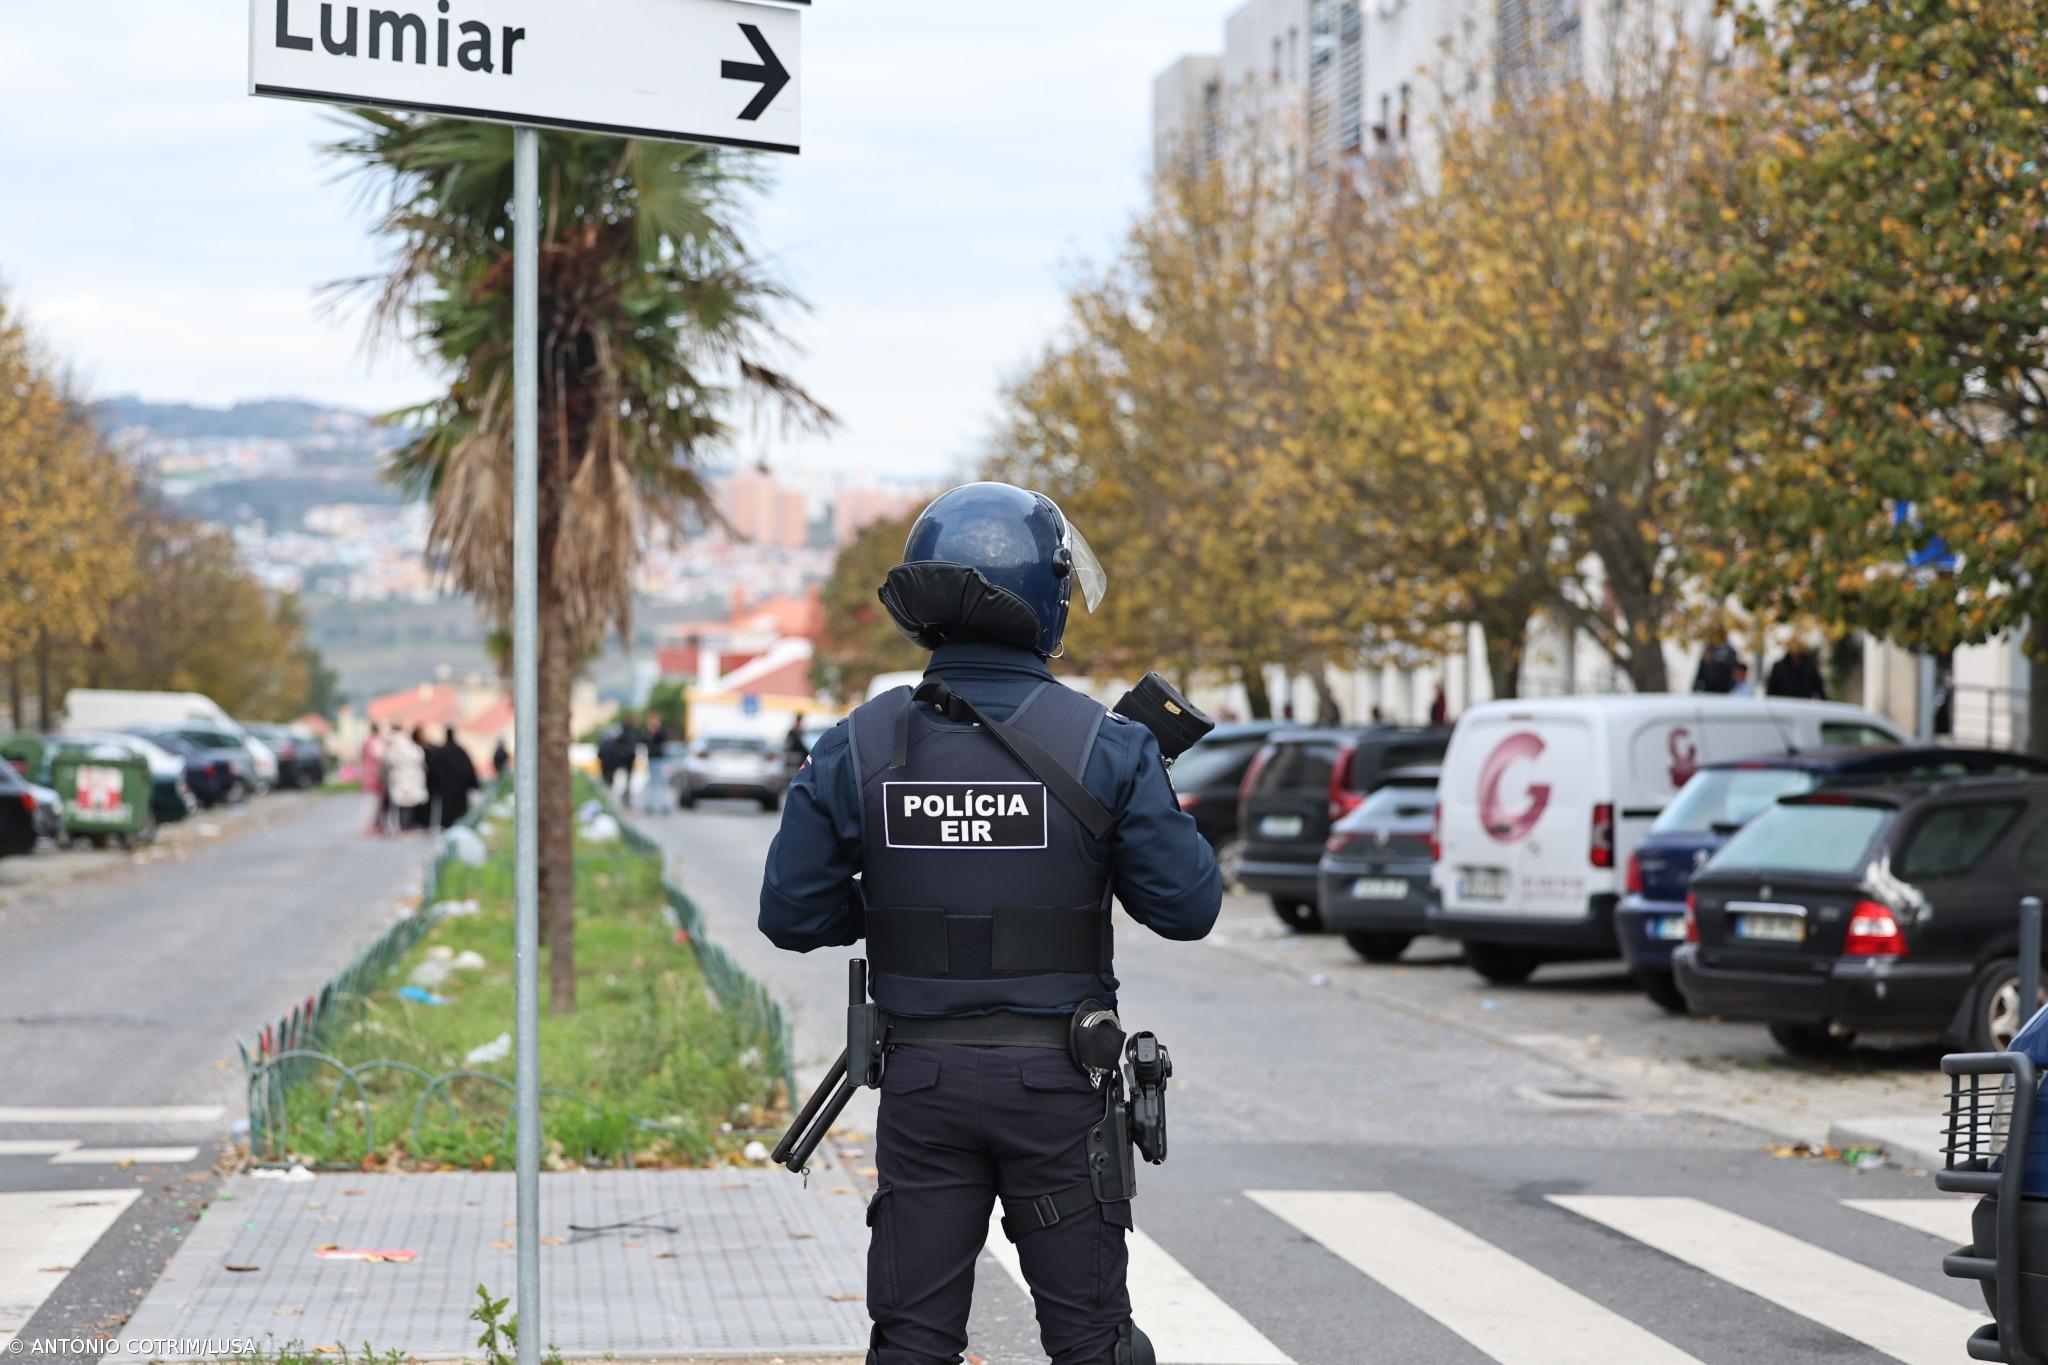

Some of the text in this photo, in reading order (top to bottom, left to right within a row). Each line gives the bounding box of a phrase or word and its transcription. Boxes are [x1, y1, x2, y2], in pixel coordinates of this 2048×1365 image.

[275, 0, 525, 75] Lumiar
[903, 789, 1029, 817] POLÍCIA
[1478, 730, 1552, 845] G
[941, 820, 993, 842] EIR
